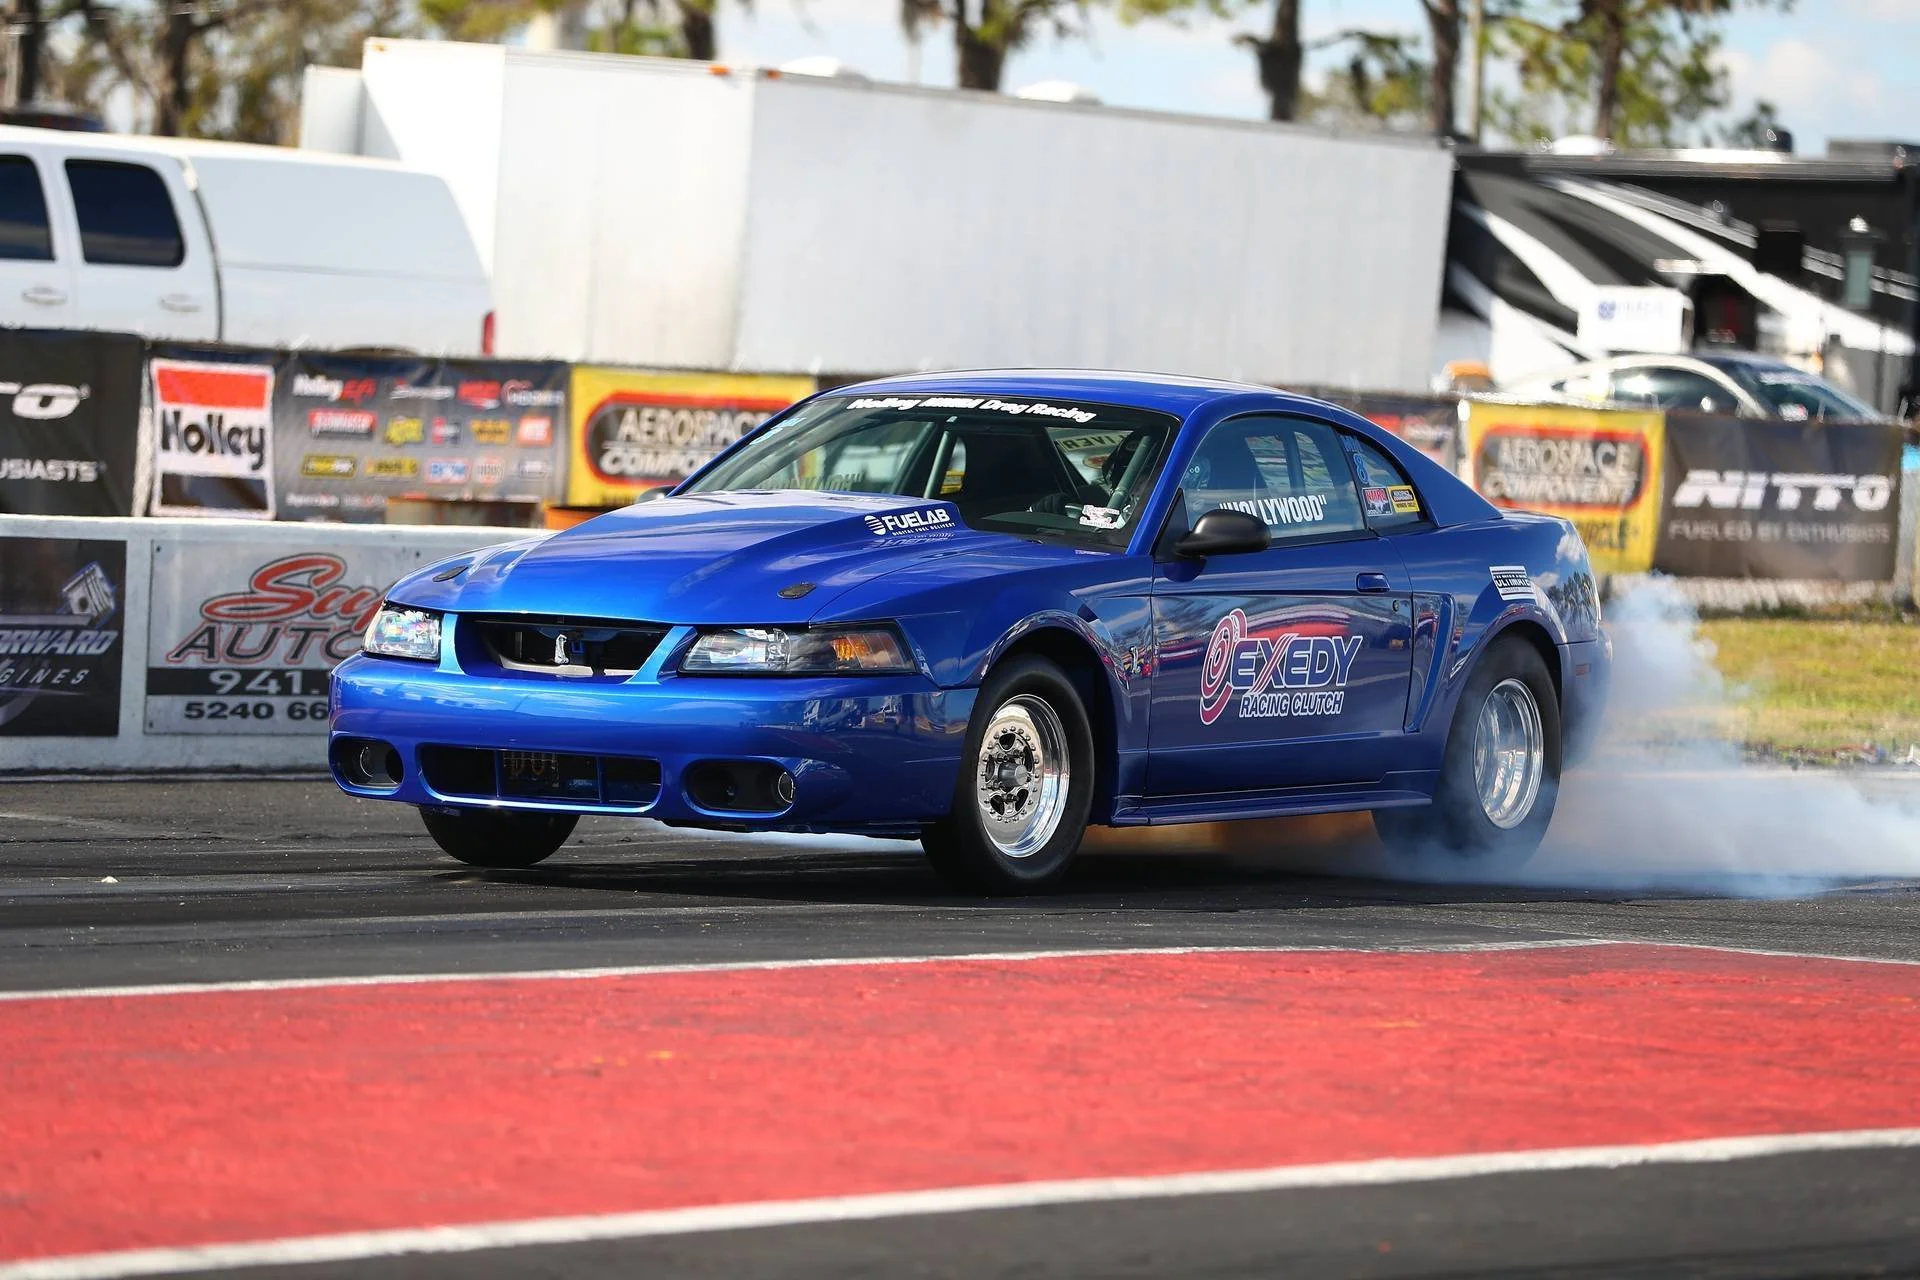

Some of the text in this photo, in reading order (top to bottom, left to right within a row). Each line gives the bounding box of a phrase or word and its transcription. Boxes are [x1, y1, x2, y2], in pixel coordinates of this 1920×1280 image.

[847, 397, 921, 411] Holley
[979, 399, 1029, 415] Drag
[1025, 403, 1097, 423] Racing
[161, 408, 265, 471] Holley
[600, 448, 714, 478] COMPO
[1498, 437, 1632, 475] AEROSPACE
[1673, 469, 1891, 511] NITTO
[881, 508, 950, 531] FUELAB
[1668, 519, 1752, 542] FUELED
[0, 668, 90, 685] GINES
[1230, 633, 1363, 694] EXEDY
[208, 670, 328, 697] 941.
[184, 702, 328, 721] 5240 66
[1239, 691, 1345, 717] RACING CLUTCH
